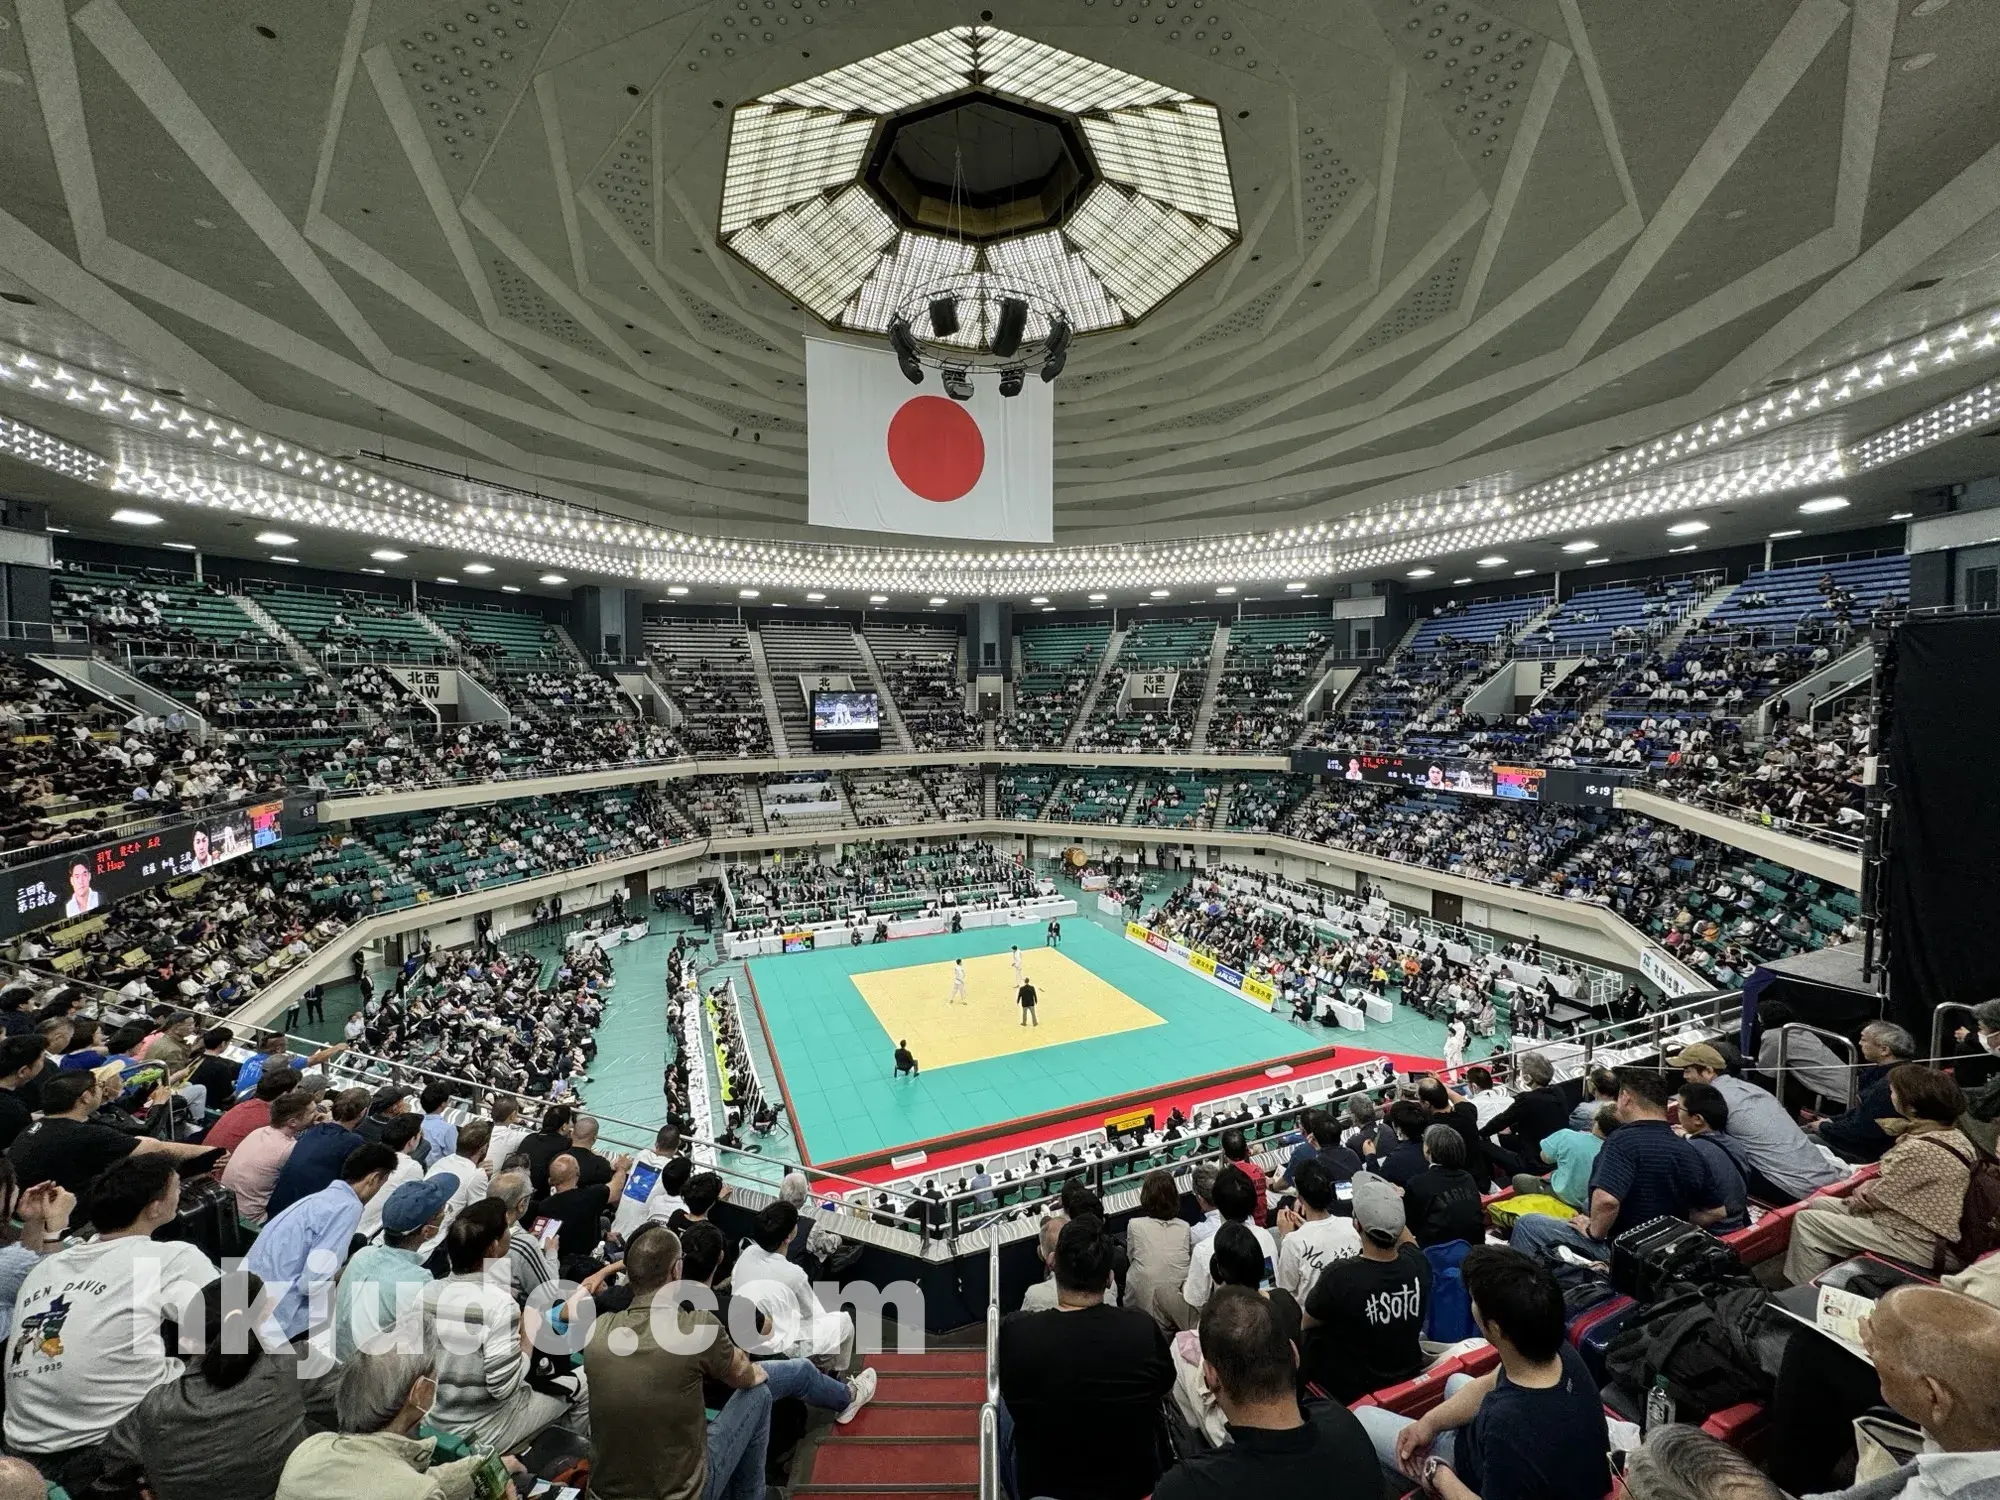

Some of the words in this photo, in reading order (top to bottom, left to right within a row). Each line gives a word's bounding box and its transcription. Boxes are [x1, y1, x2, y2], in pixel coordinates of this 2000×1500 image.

[1541, 662, 1556, 675] 東
[408, 672, 439, 684] 北西
[819, 677, 830, 686] 北
[1144, 675, 1165, 684] 北東
[1144, 685, 1165, 694] NE
[1515, 768, 1544, 777] SEIKO
[24, 1286, 52, 1308] BEN
[62, 1280, 107, 1295] DAVIS
[37, 1361, 62, 1374] 1935
